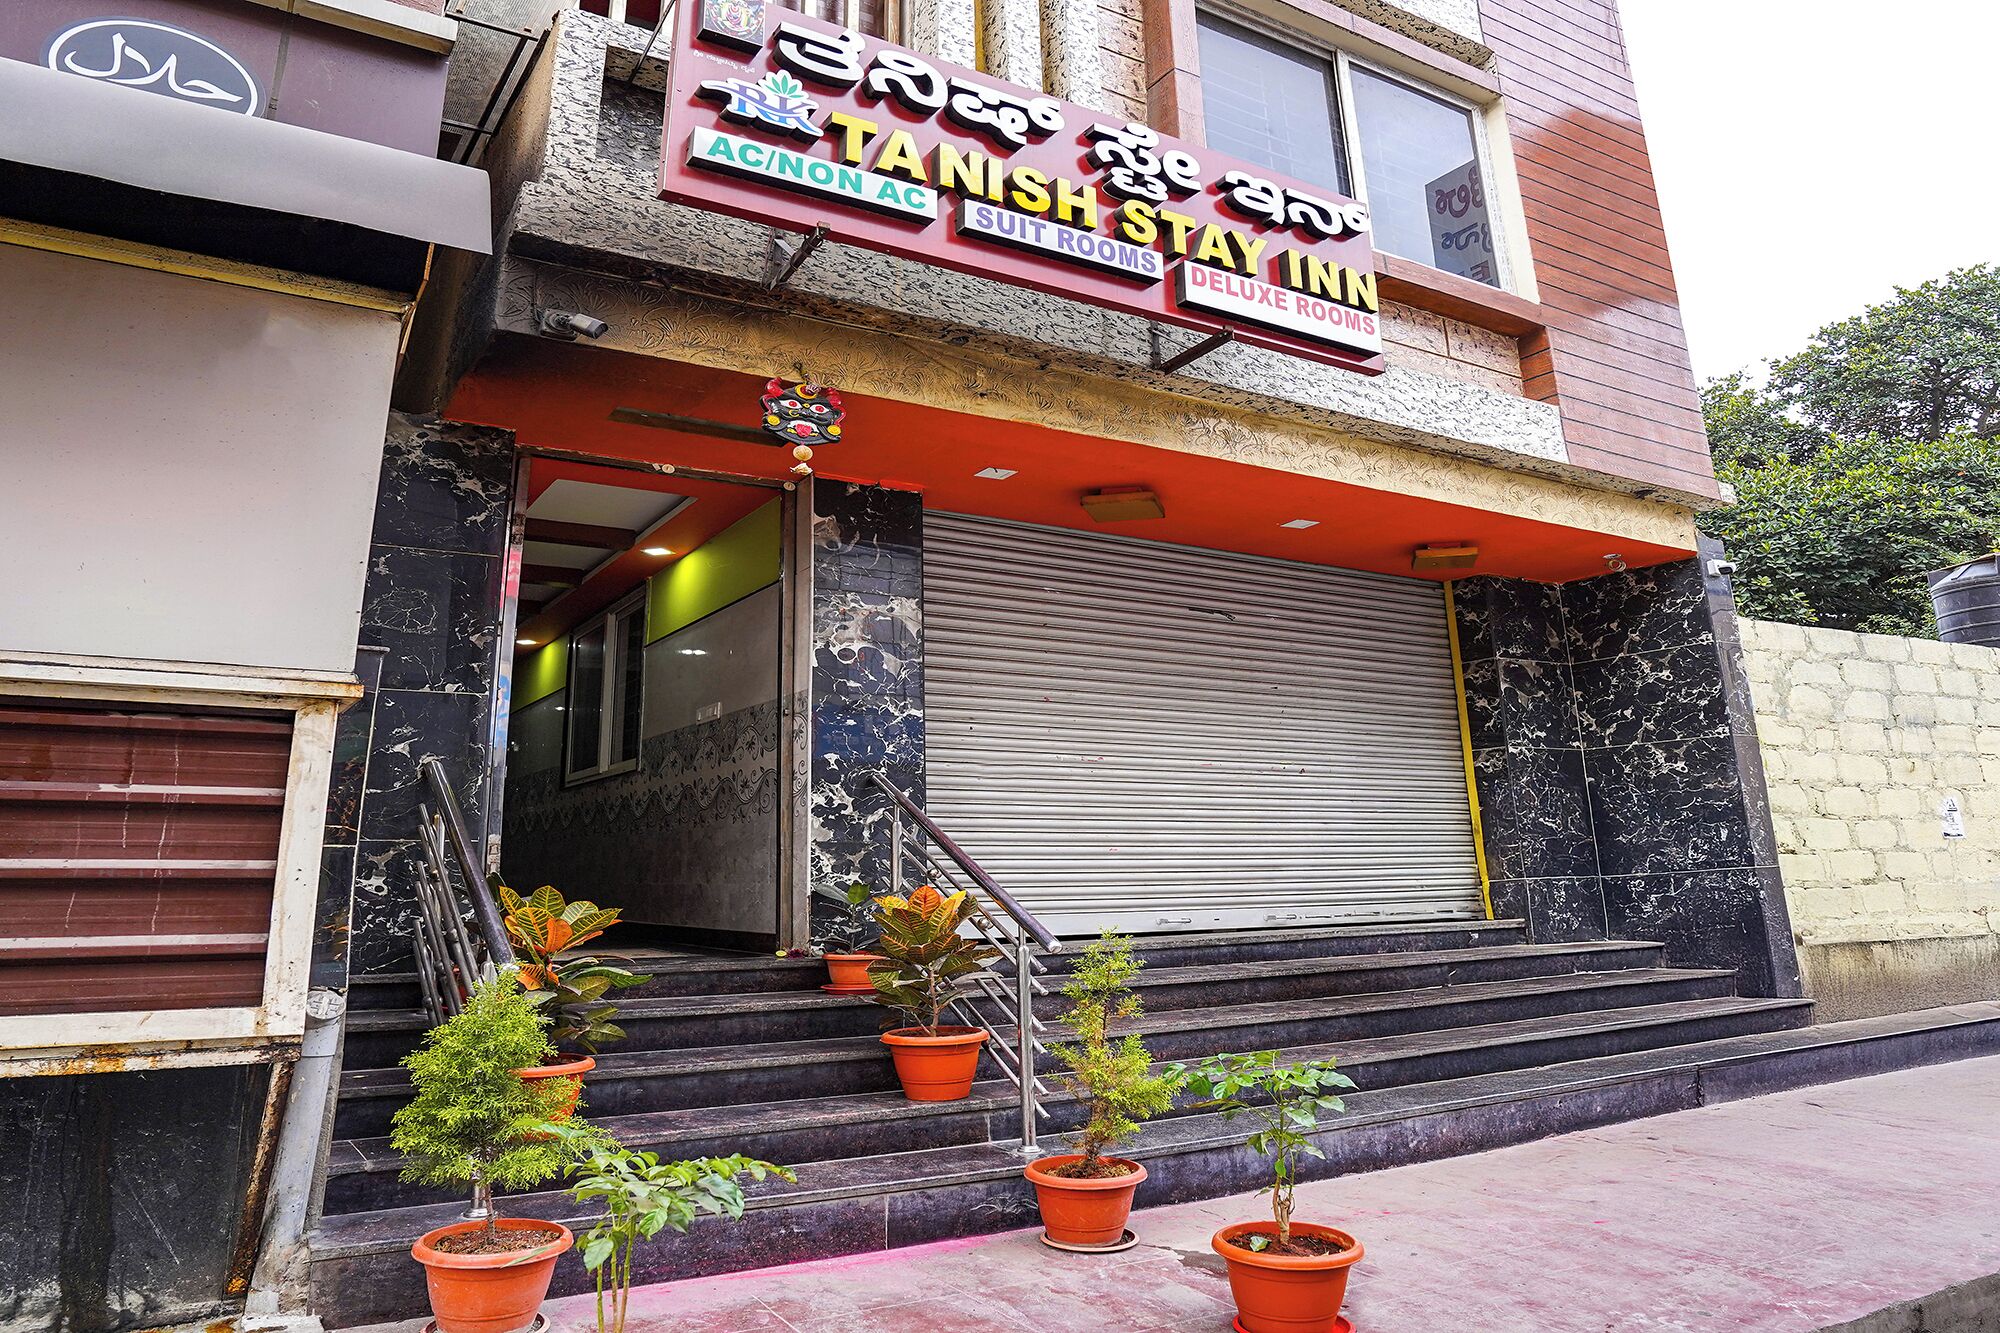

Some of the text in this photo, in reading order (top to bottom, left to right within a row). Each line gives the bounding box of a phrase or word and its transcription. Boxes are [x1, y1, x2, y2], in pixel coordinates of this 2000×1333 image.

[64, 32, 243, 102] حلال
[707, 136, 926, 209] AC/NON AC
[1225, 170, 1370, 235] ಇನ್
[831, 112, 1378, 312] TANISH STAY INN
[976, 206, 1157, 273] SUIT ROOMS
[1191, 266, 1376, 336] DELUXE ROOMS
